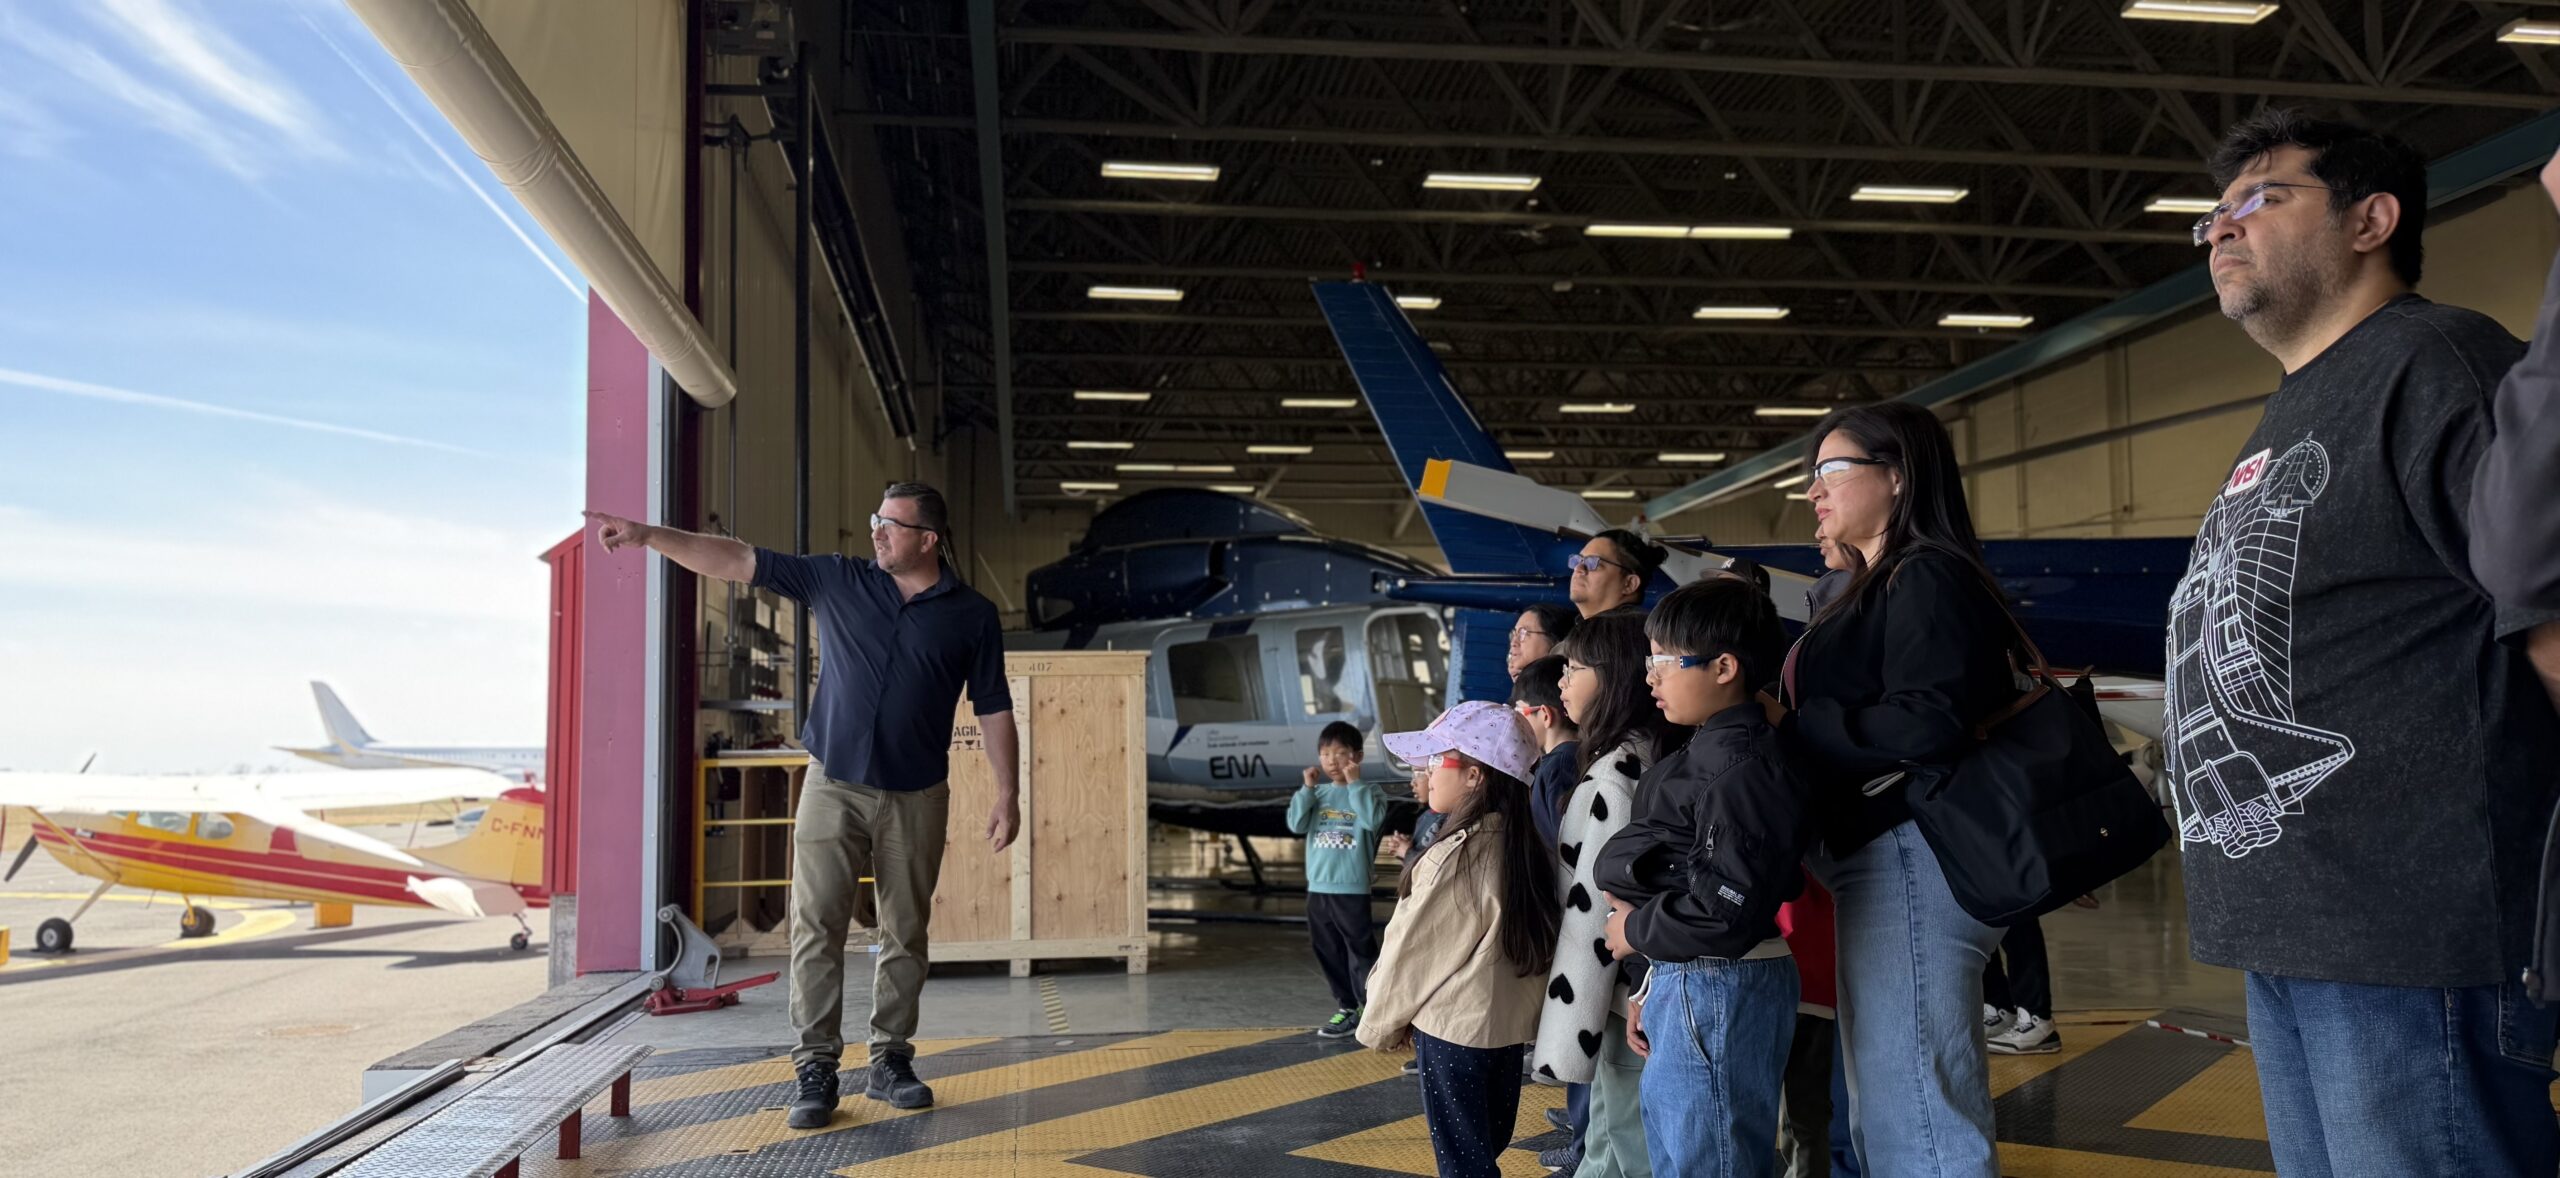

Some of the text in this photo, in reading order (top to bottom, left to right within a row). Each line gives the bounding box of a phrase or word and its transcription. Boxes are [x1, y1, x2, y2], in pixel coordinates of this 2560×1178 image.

[1028, 661, 1053, 673] 407
[953, 725, 983, 737] AGIL
[1209, 753, 1271, 780] ENA
